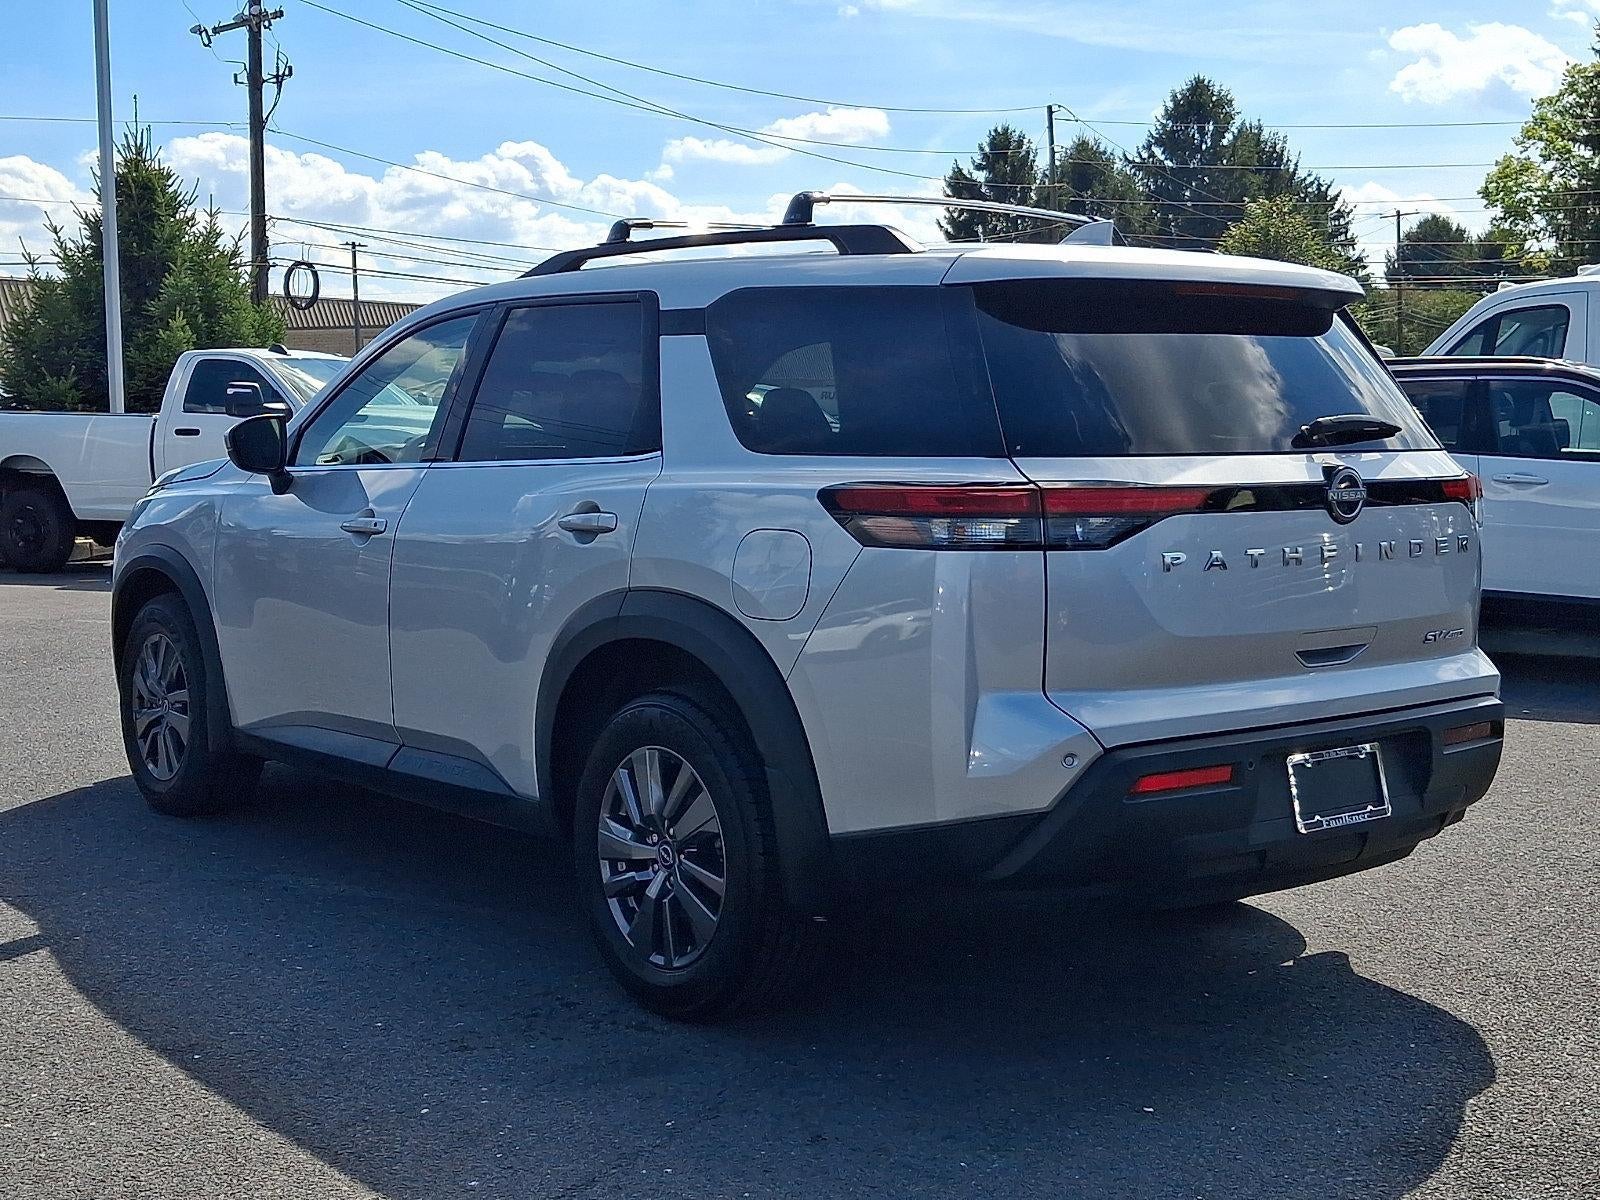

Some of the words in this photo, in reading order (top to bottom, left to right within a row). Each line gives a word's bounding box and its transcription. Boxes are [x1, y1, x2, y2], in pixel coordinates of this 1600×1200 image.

[1329, 490, 1366, 500] NISSAN
[1161, 535, 1470, 573] PATHFINDER
[1322, 812, 1370, 828] Faulkner
